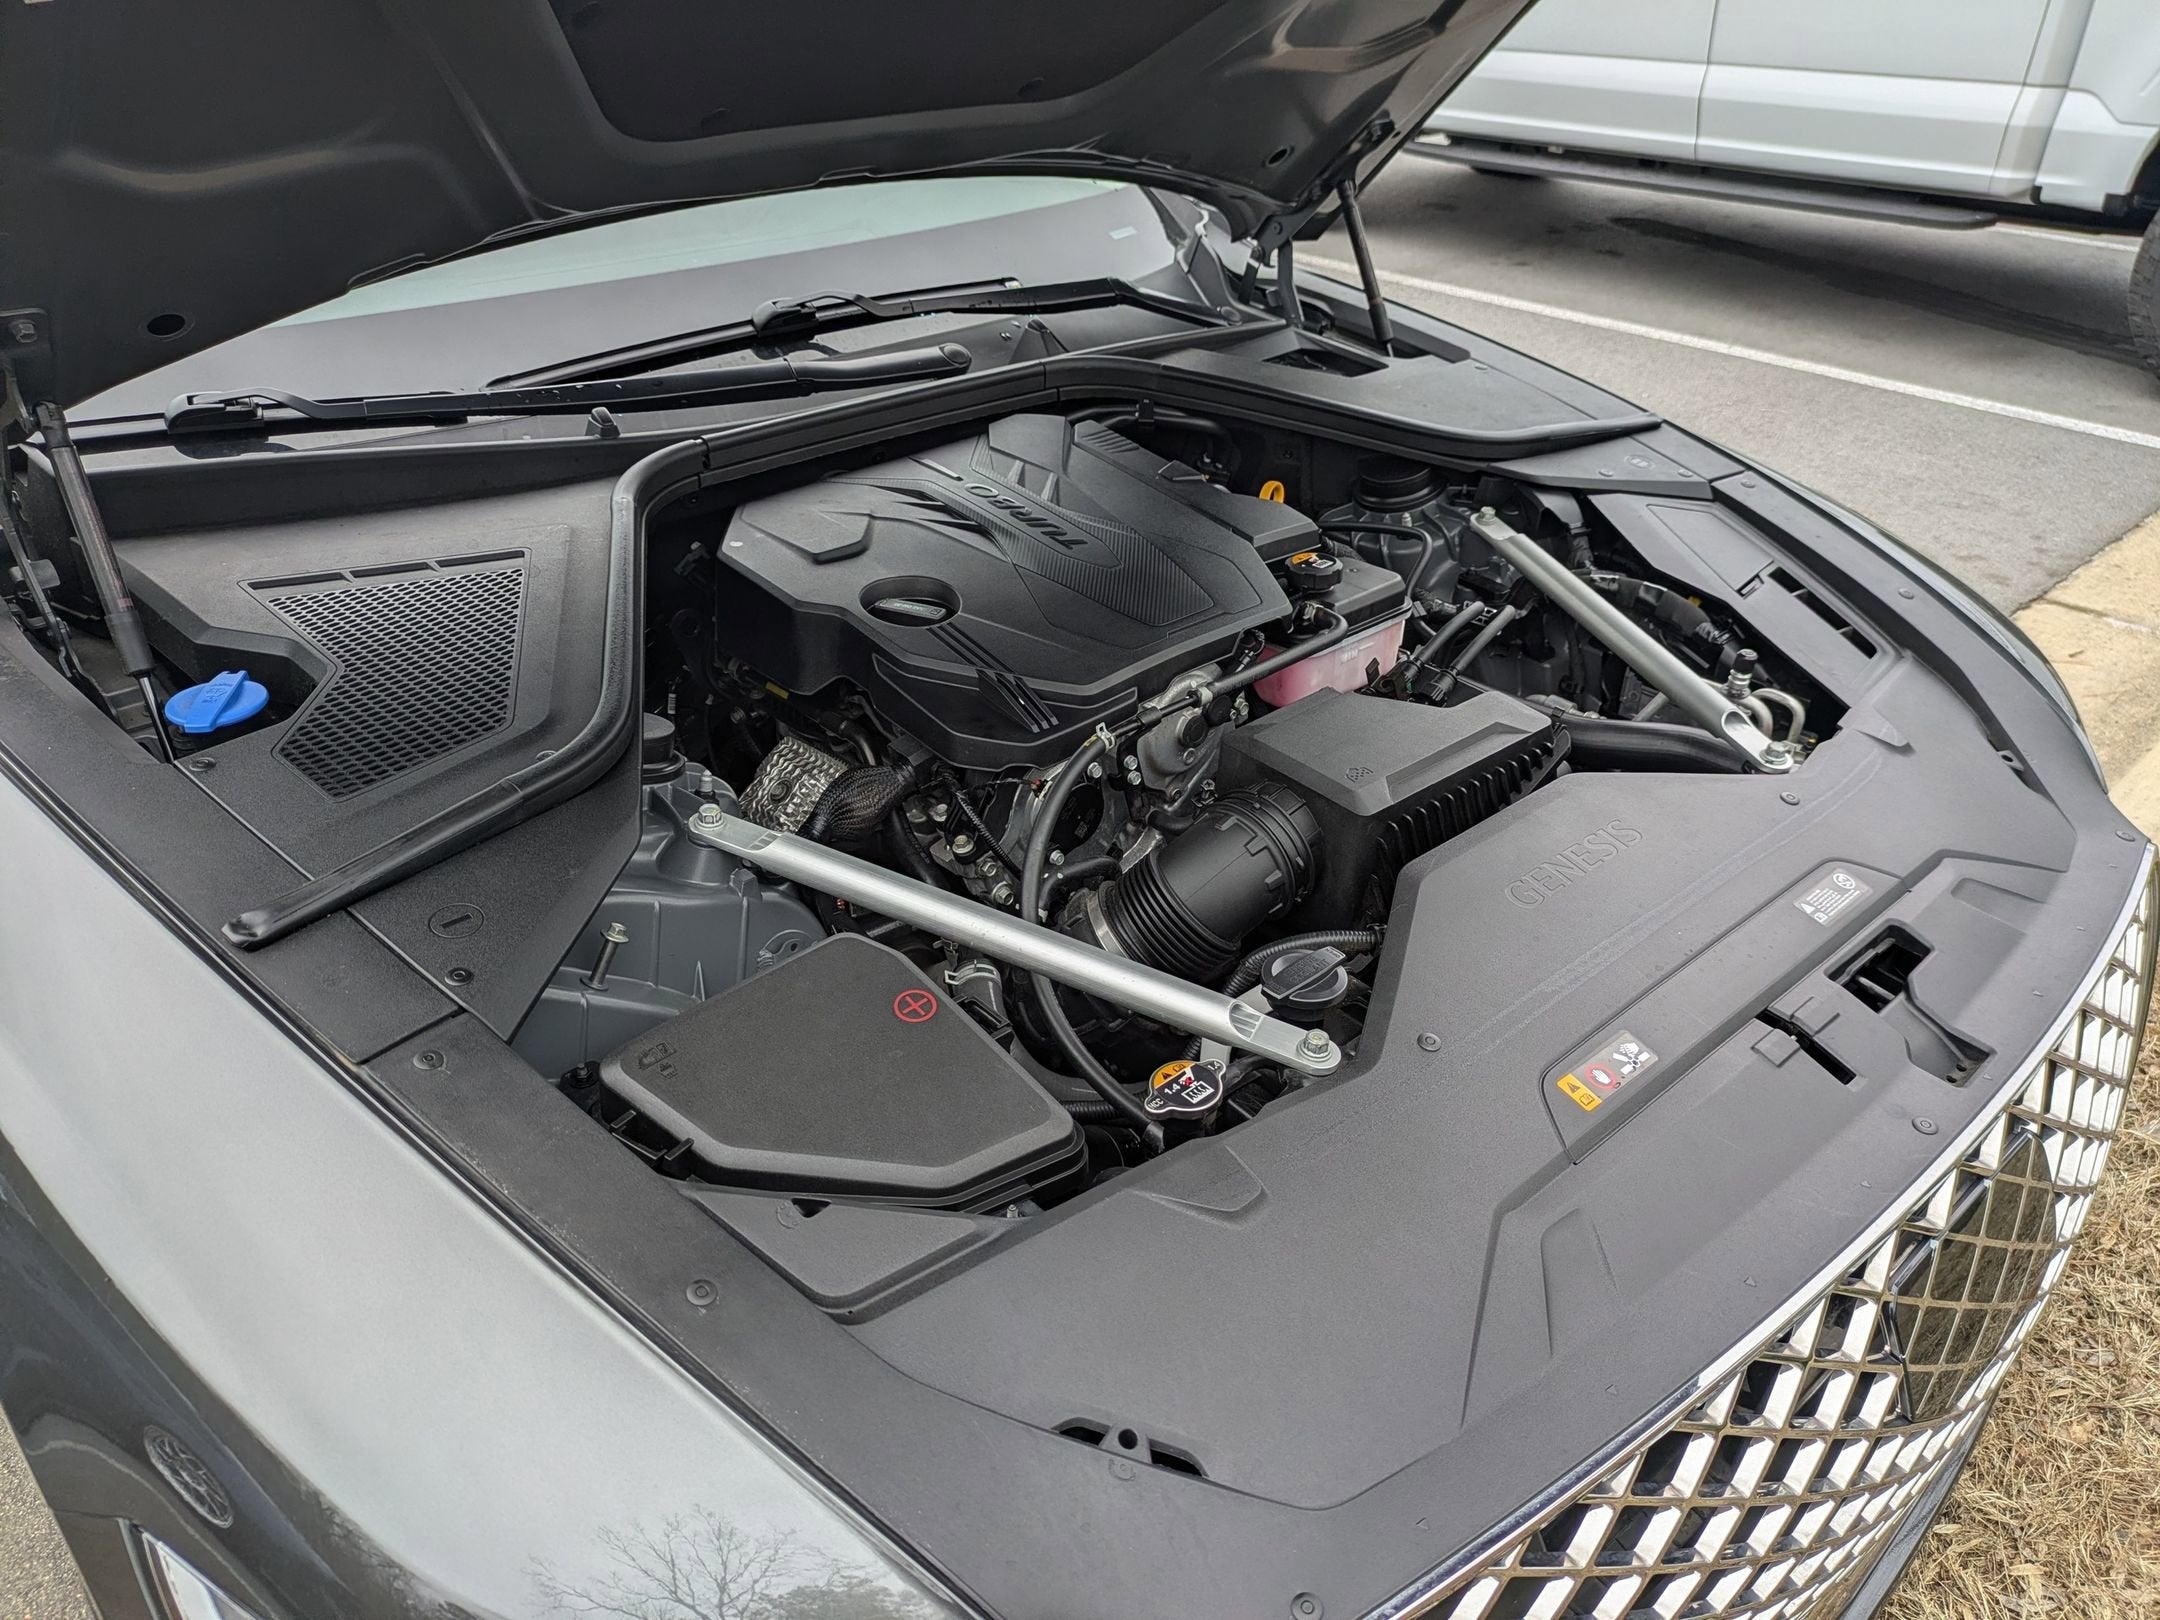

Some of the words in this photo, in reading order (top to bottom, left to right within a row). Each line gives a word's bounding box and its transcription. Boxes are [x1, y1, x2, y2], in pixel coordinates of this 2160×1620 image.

[964, 482, 1089, 550] TURBO
[1504, 818, 1643, 909] GENESIS
[1164, 1083, 1181, 1095] 1.4
